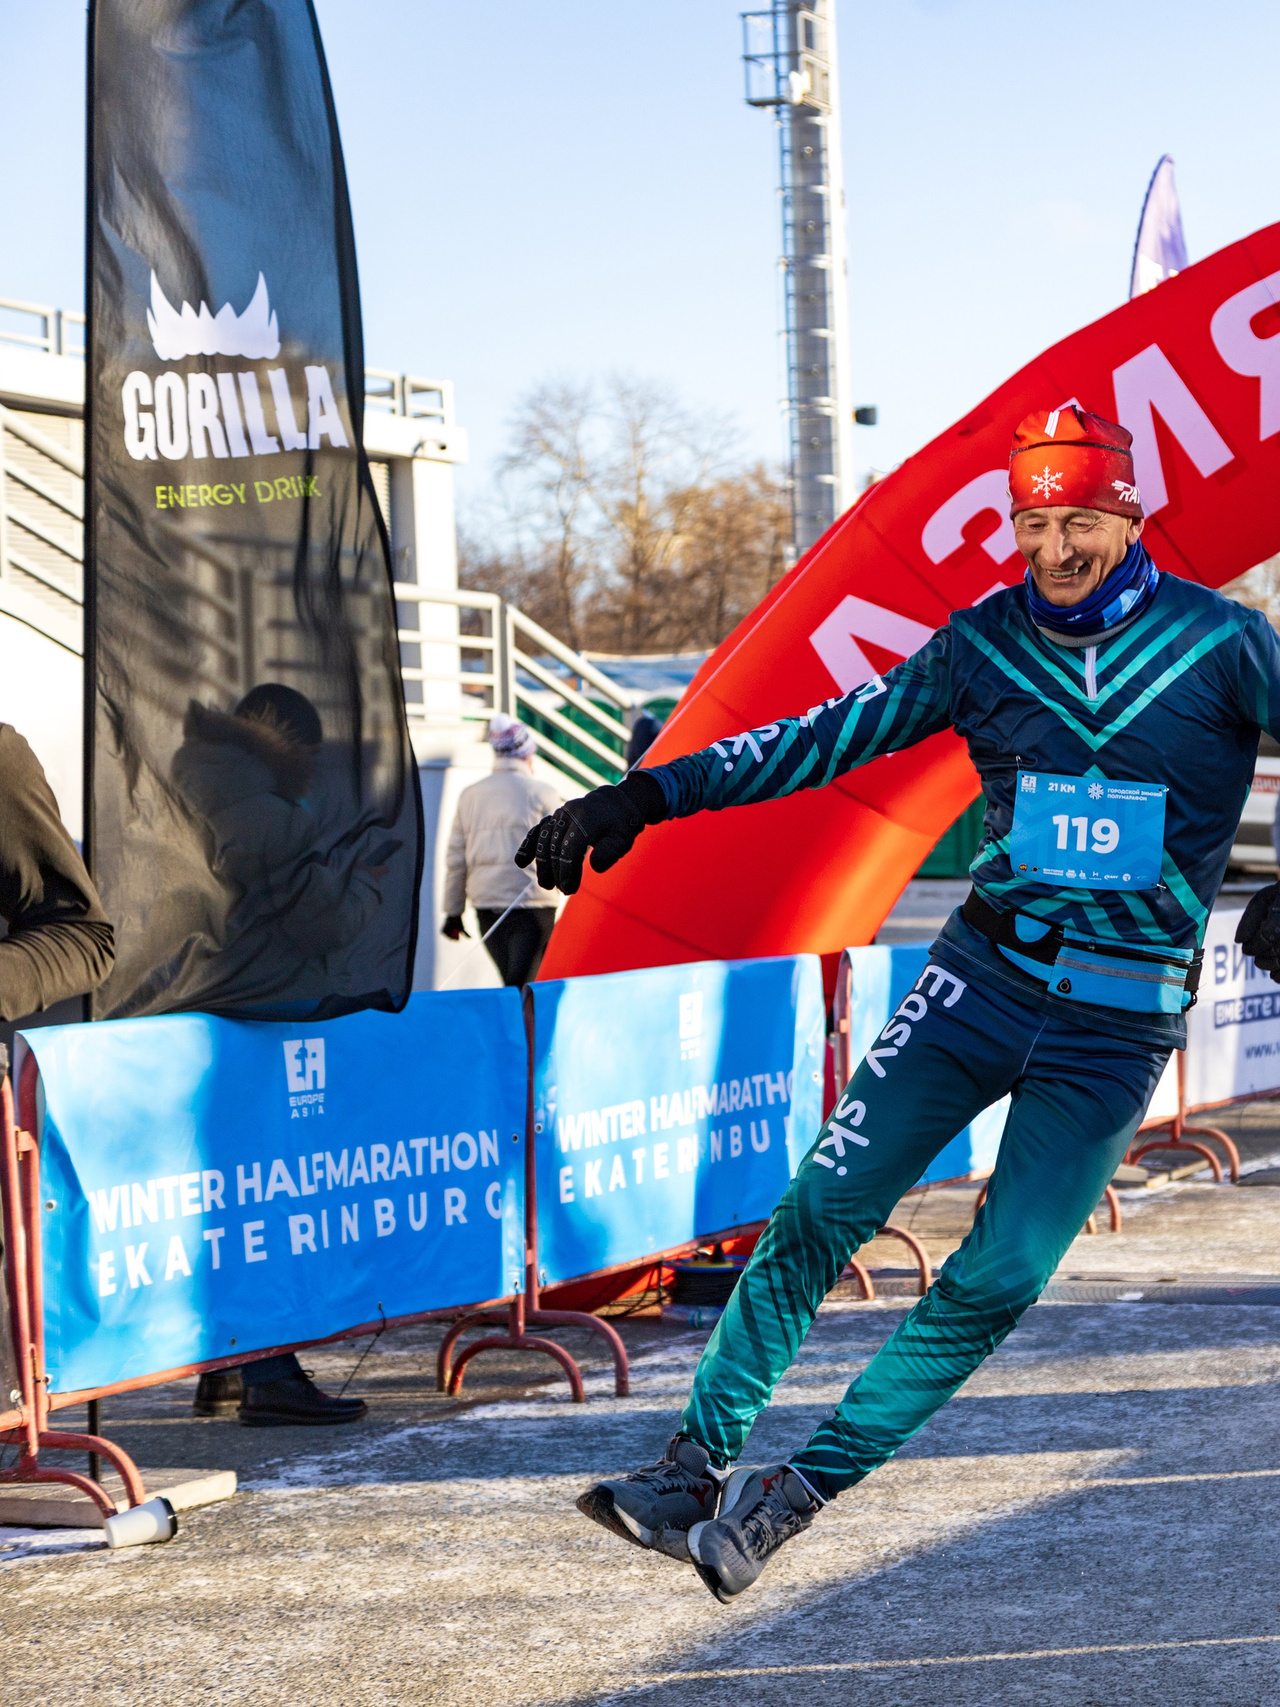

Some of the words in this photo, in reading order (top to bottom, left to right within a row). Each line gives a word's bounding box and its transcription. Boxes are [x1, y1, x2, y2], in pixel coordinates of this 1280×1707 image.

[121, 365, 349, 461] GORILLA
[156, 481, 247, 510] ENERGY
[257, 474, 321, 504] DRINK
[1048, 782, 1060, 792] 21
[1052, 814, 1120, 854] 119
[289, 1092, 325, 1107] EUROPE
[290, 1104, 325, 1120] ASIA
[558, 1100, 647, 1153] WINTER
[812, 1093, 870, 1176] ski
[89, 1169, 225, 1235] WINTER
[236, 1129, 500, 1203] HALFMARATHON
[559, 1115, 791, 1204] EKATERINBU
[99, 1181, 502, 1297] EKATERINBURG
